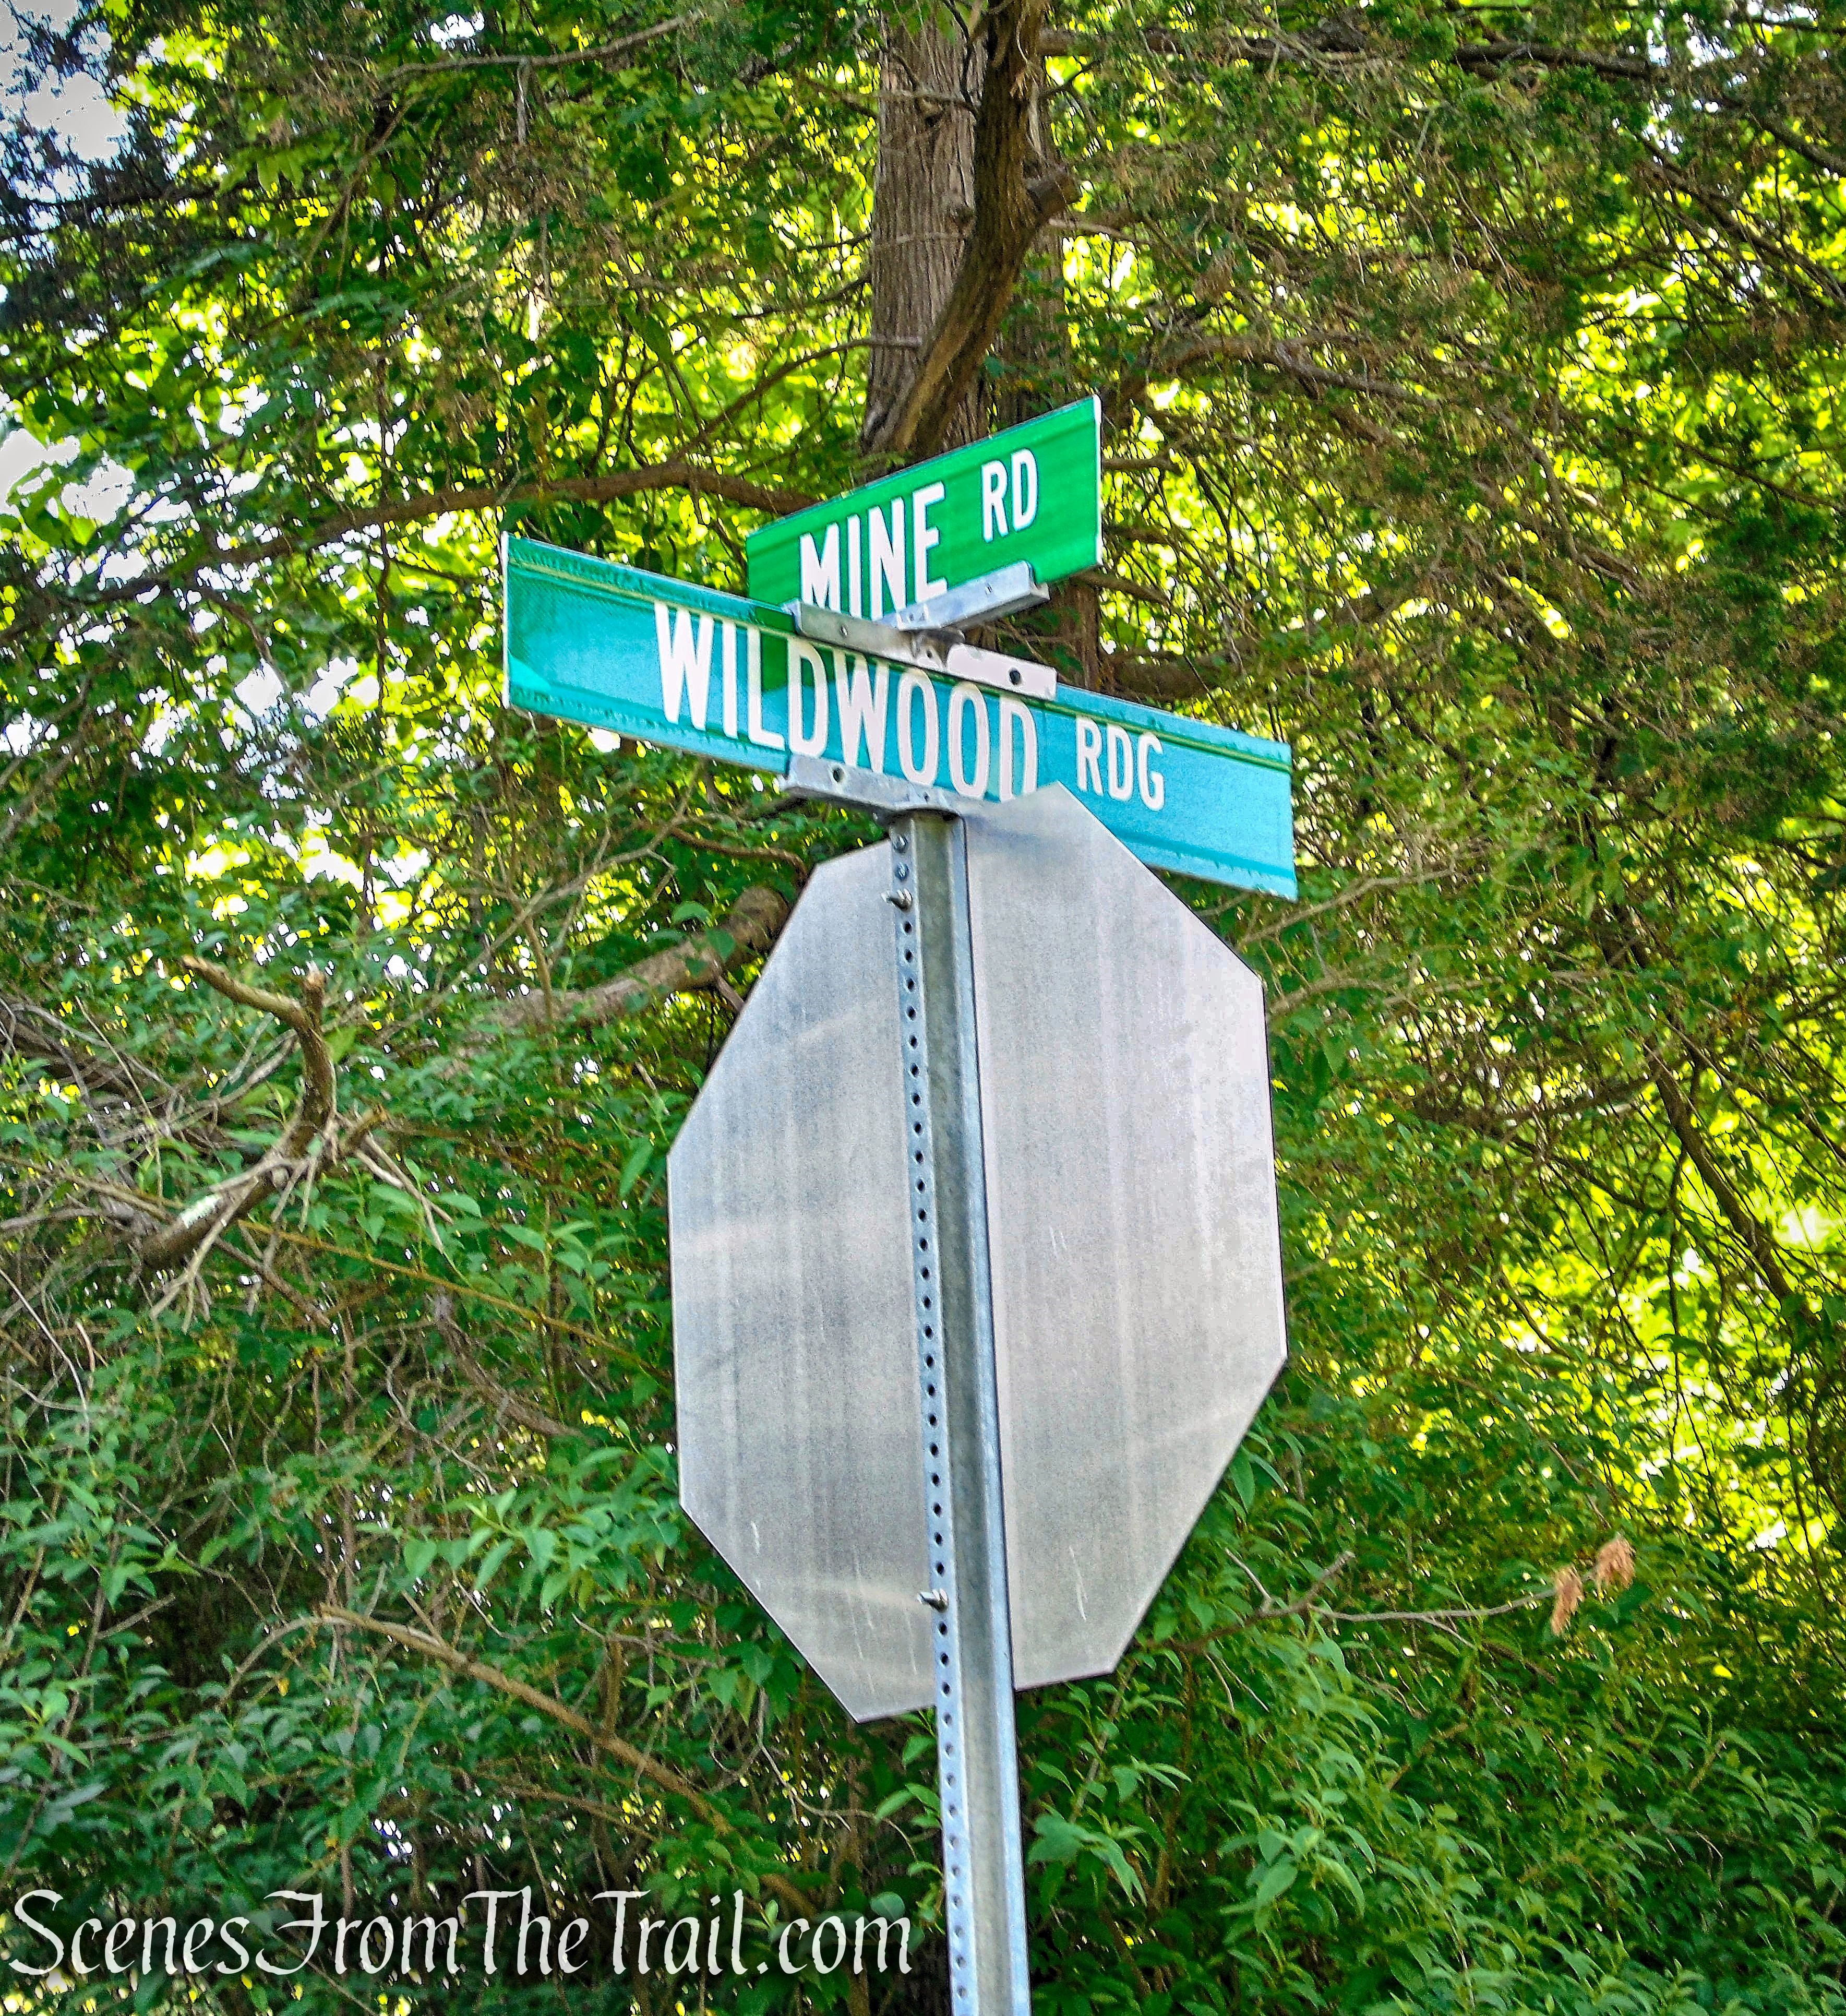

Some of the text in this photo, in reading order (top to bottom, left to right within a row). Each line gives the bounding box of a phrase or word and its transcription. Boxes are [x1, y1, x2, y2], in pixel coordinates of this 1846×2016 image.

[800, 448, 1038, 621] MINE RD
[654, 601, 1165, 812] WILDWOOD RDG
